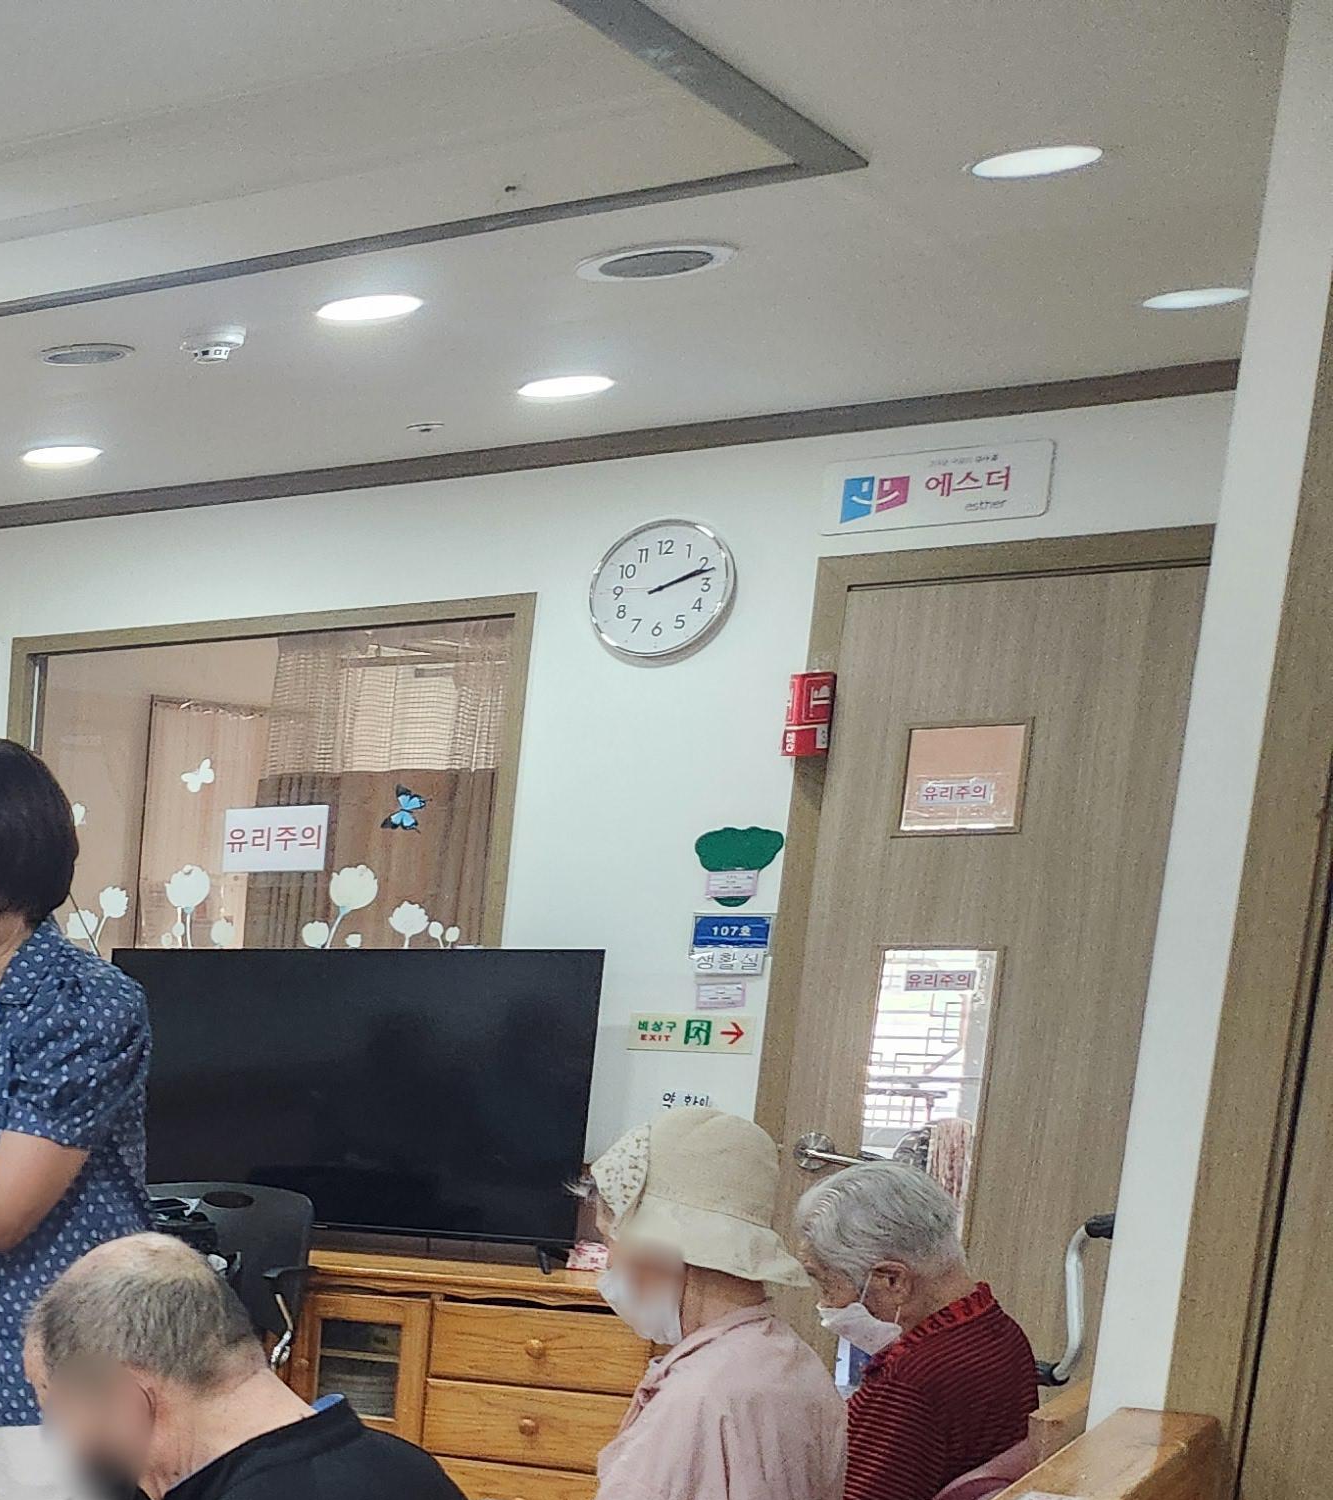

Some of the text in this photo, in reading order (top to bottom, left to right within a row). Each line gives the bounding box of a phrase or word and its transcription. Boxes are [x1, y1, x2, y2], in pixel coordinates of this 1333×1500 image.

[925, 465, 1011, 497] 에스더
[964, 500, 1008, 512] esther
[657, 539, 674, 555] 12
[686, 543, 692, 559] 1
[638, 548, 649, 563] 11
[699, 556, 709, 570] 2
[619, 563, 636, 579] 10
[701, 577, 711, 592] 3
[613, 585, 623, 600] 9
[616, 604, 626, 619] 8
[691, 597, 702, 612] 4
[631, 618, 642, 633] 7
[651, 621, 662, 637] 6
[674, 614, 686, 629] 5
[922, 784, 987, 801] 유리주의
[226, 825, 322, 853] 유리주의
[711, 925, 752, 937] 107호
[696, 952, 759, 971] 생활실
[907, 973, 972, 988] 유리주의
[637, 1020, 677, 1033] 비상구
[640, 1033, 672, 1042] EXIT
